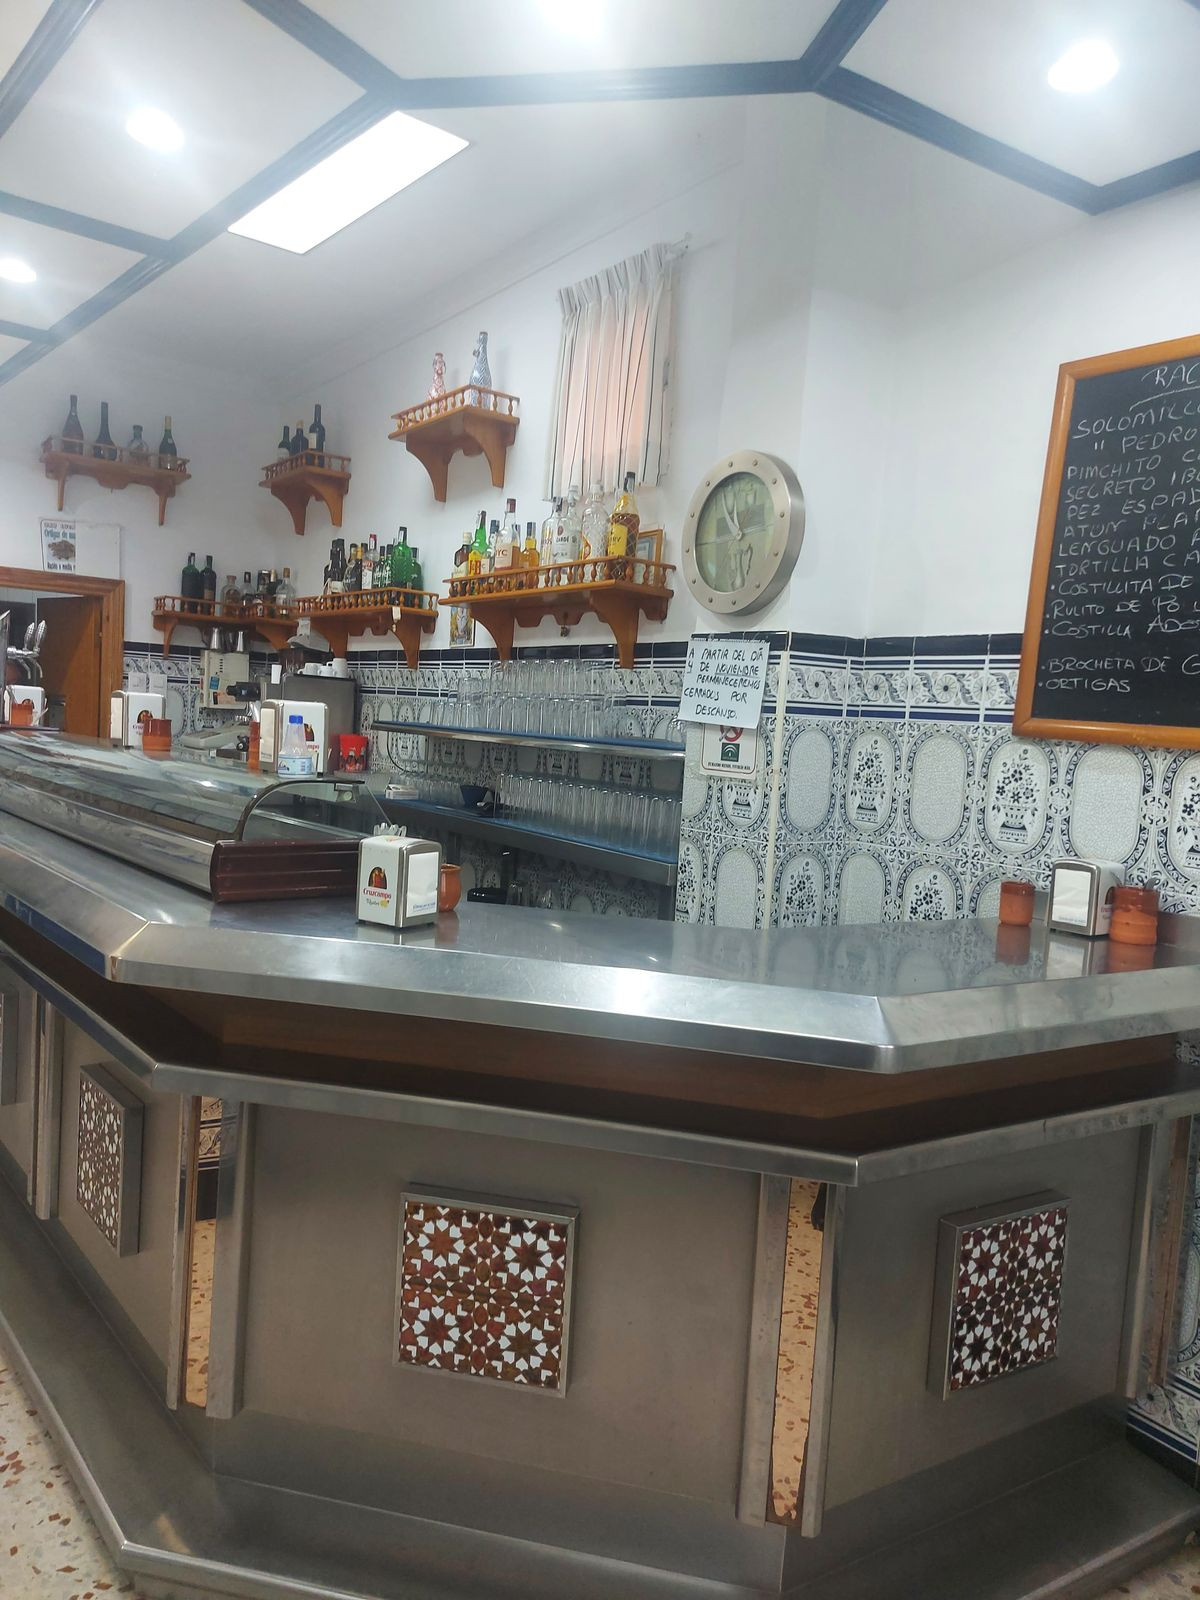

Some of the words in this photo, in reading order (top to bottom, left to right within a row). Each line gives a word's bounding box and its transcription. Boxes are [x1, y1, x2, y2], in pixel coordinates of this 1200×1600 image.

[1072, 401, 1200, 439] SOLOMILL
[1122, 425, 1198, 454] PEDRO
[1065, 476, 1156, 503] SECRETO
[1059, 534, 1176, 557] LENGUADO
[1055, 555, 1149, 578] TORTILLA
[1159, 573, 1193, 591] DE
[1115, 600, 1141, 613] DE
[1051, 621, 1132, 639] COSTILLA
[689, 647, 695, 658] A
[702, 648, 729, 660] PARTIR
[732, 649, 745, 662] DEL
[700, 661, 710, 672] DE
[1049, 656, 1135, 673] BROCHETA
[1141, 656, 1171, 673] DE
[1046, 678, 1130, 693] ORTIGAS
[684, 687, 719, 701] CERRADOS
[731, 691, 747, 704] POR
[363, 887, 392, 900] Cruzcampo
